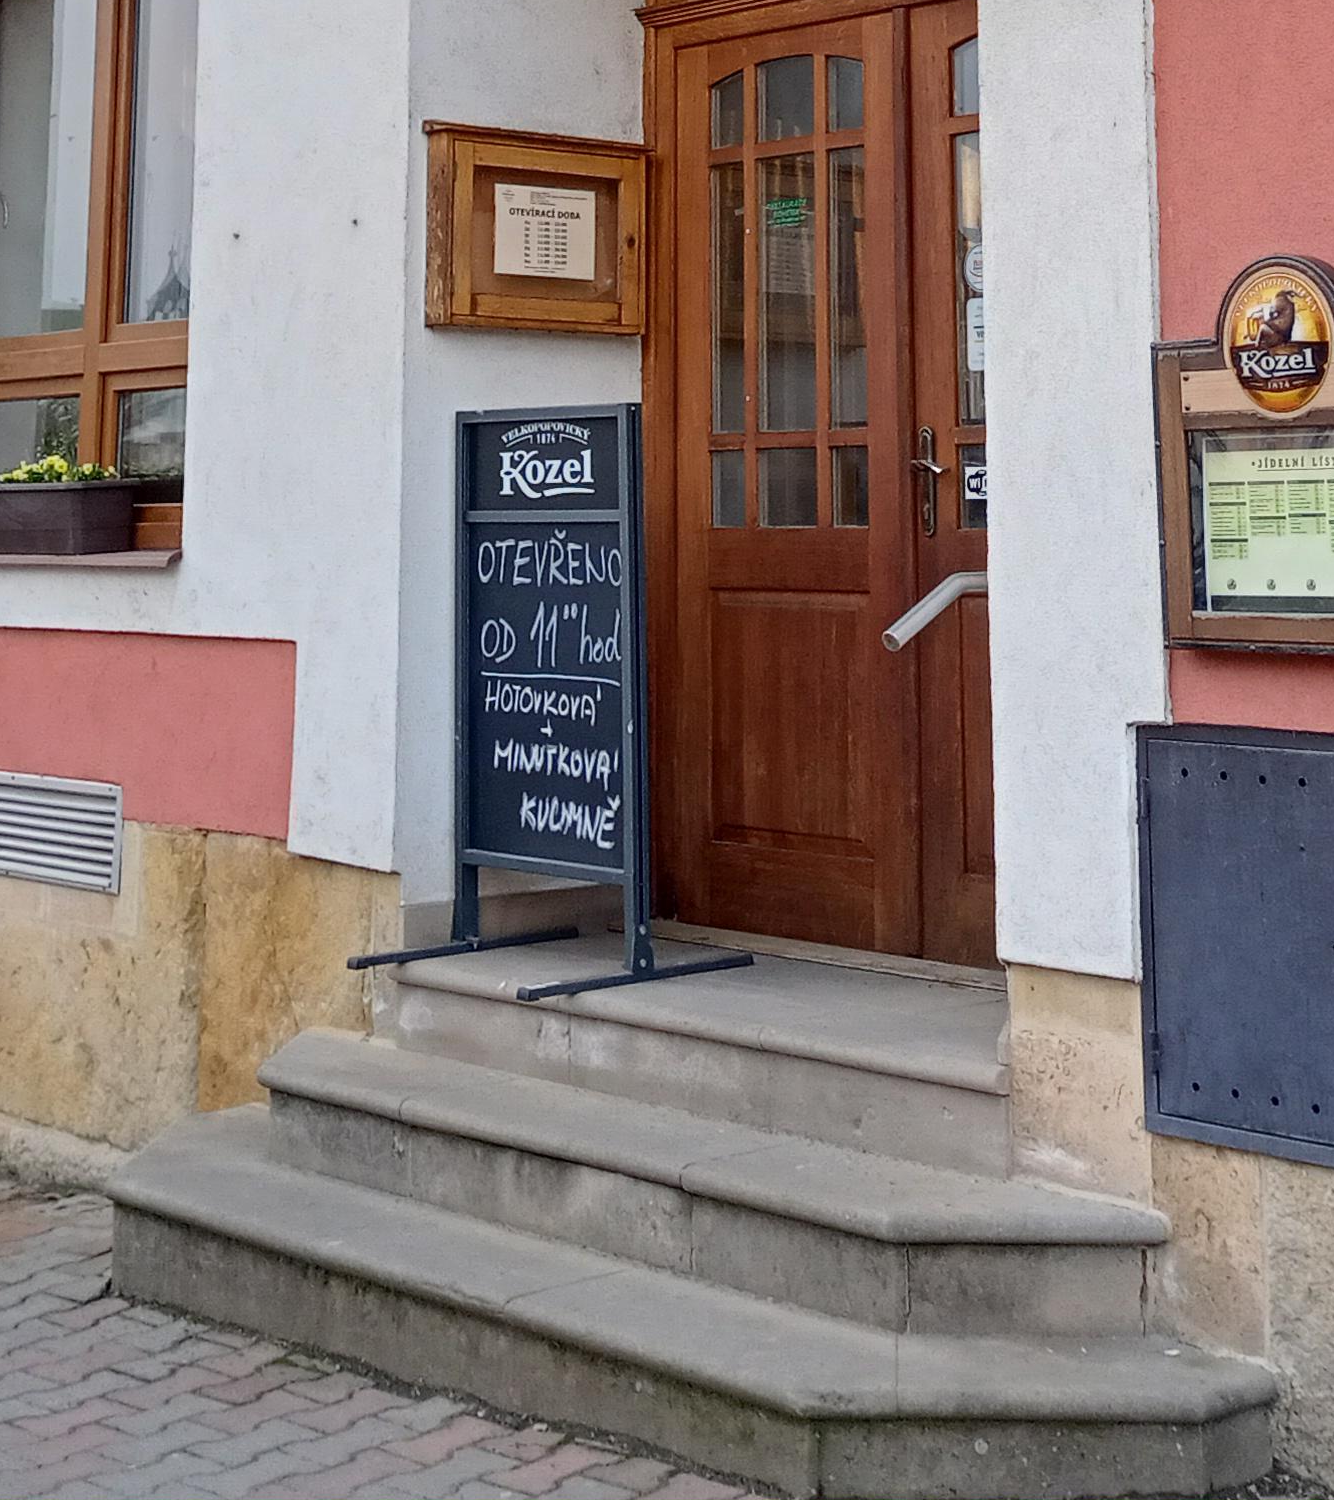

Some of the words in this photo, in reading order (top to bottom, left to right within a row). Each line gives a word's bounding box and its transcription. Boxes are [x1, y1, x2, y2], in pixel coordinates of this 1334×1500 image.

[508, 206, 556, 219] OTEVÍRACÍ
[557, 210, 581, 220] DOBA
[1239, 347, 1316, 378] Kozel
[500, 421, 591, 445] VELKOPOPOVICKÝ
[499, 449, 595, 498] Kozel
[1258, 456, 1305, 468] JÍDELNÍ
[478, 529, 623, 587] OTEVŘENO
[481, 618, 516, 663] OD
[579, 604, 621, 665] hod
